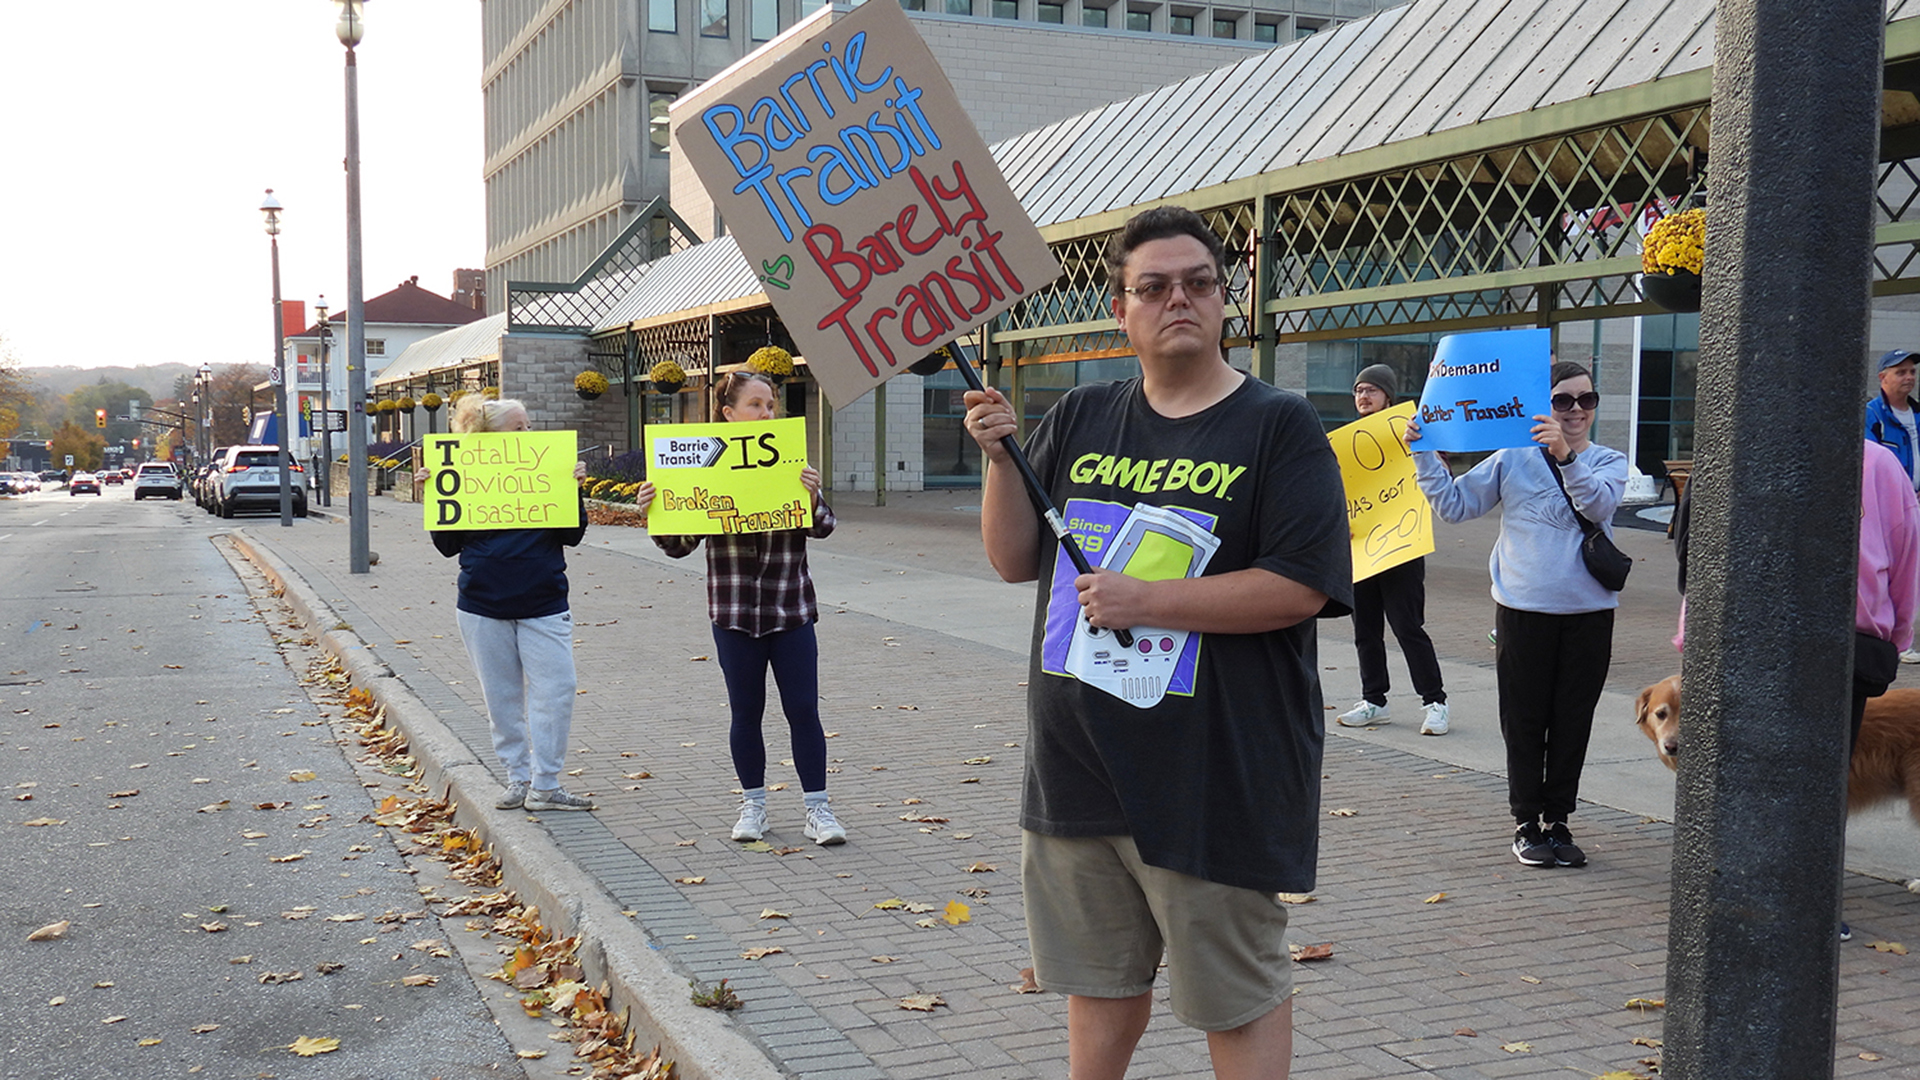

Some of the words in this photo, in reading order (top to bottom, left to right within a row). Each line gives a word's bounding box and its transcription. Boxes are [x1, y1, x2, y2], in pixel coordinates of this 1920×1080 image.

[702, 31, 893, 178] Barrie
[733, 76, 942, 243] Transit
[802, 160, 988, 299] Barely
[759, 254, 795, 290] is
[817, 220, 1024, 378] Transit
[1421, 404, 1455, 424] Better
[1455, 396, 1526, 422] Transit
[658, 452, 702, 466] Transit
[670, 440, 709, 453] Barrie
[435, 469, 551, 496] Obvious
[1378, 478, 1405, 504] GOT
[436, 498, 559, 526] Disaster
[707, 500, 807, 533] Transit
[1068, 518, 1112, 533] Since
[1365, 499, 1426, 557] GO!
